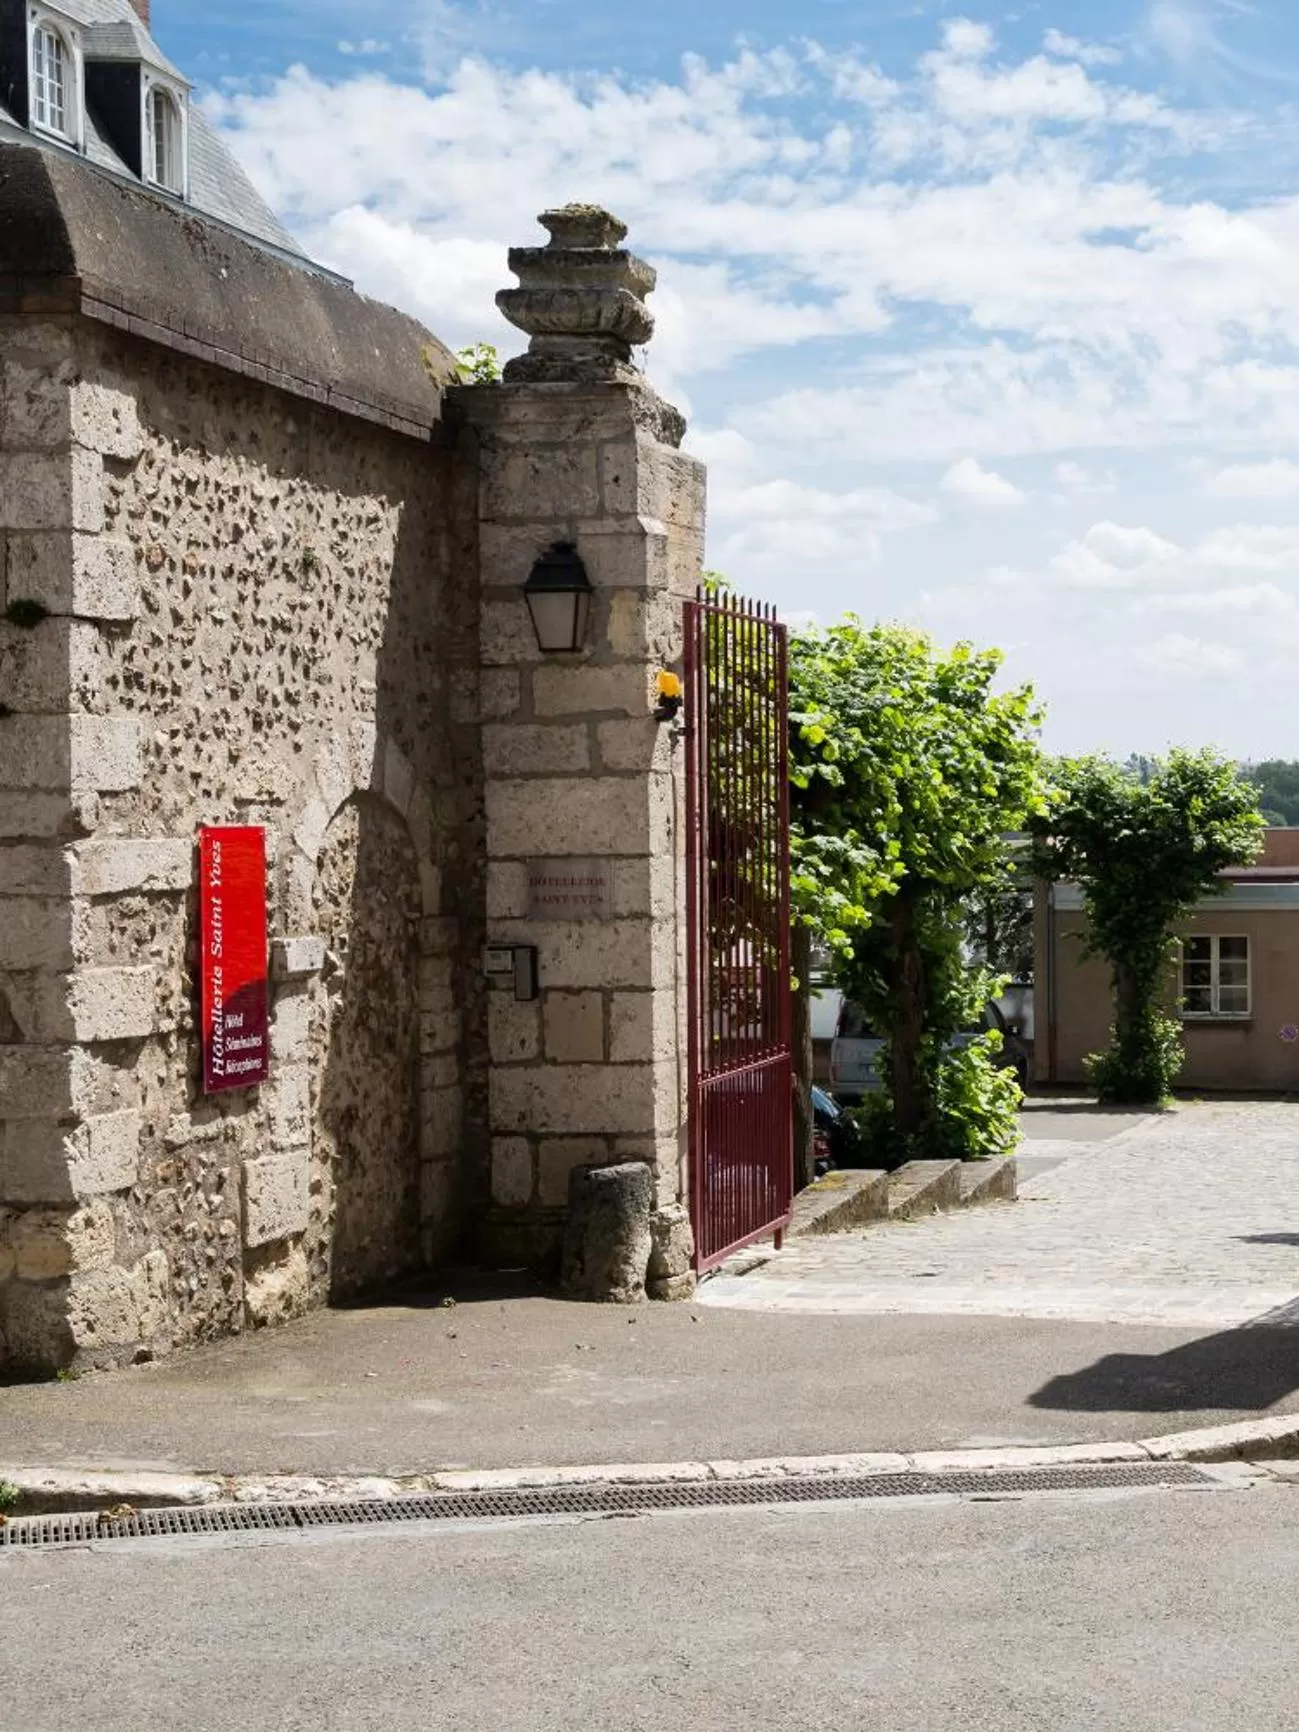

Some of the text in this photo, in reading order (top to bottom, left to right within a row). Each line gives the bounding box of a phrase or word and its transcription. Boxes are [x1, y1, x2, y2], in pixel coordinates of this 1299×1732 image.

[209, 839, 225, 1077] Hôtellerie Saint Yves
